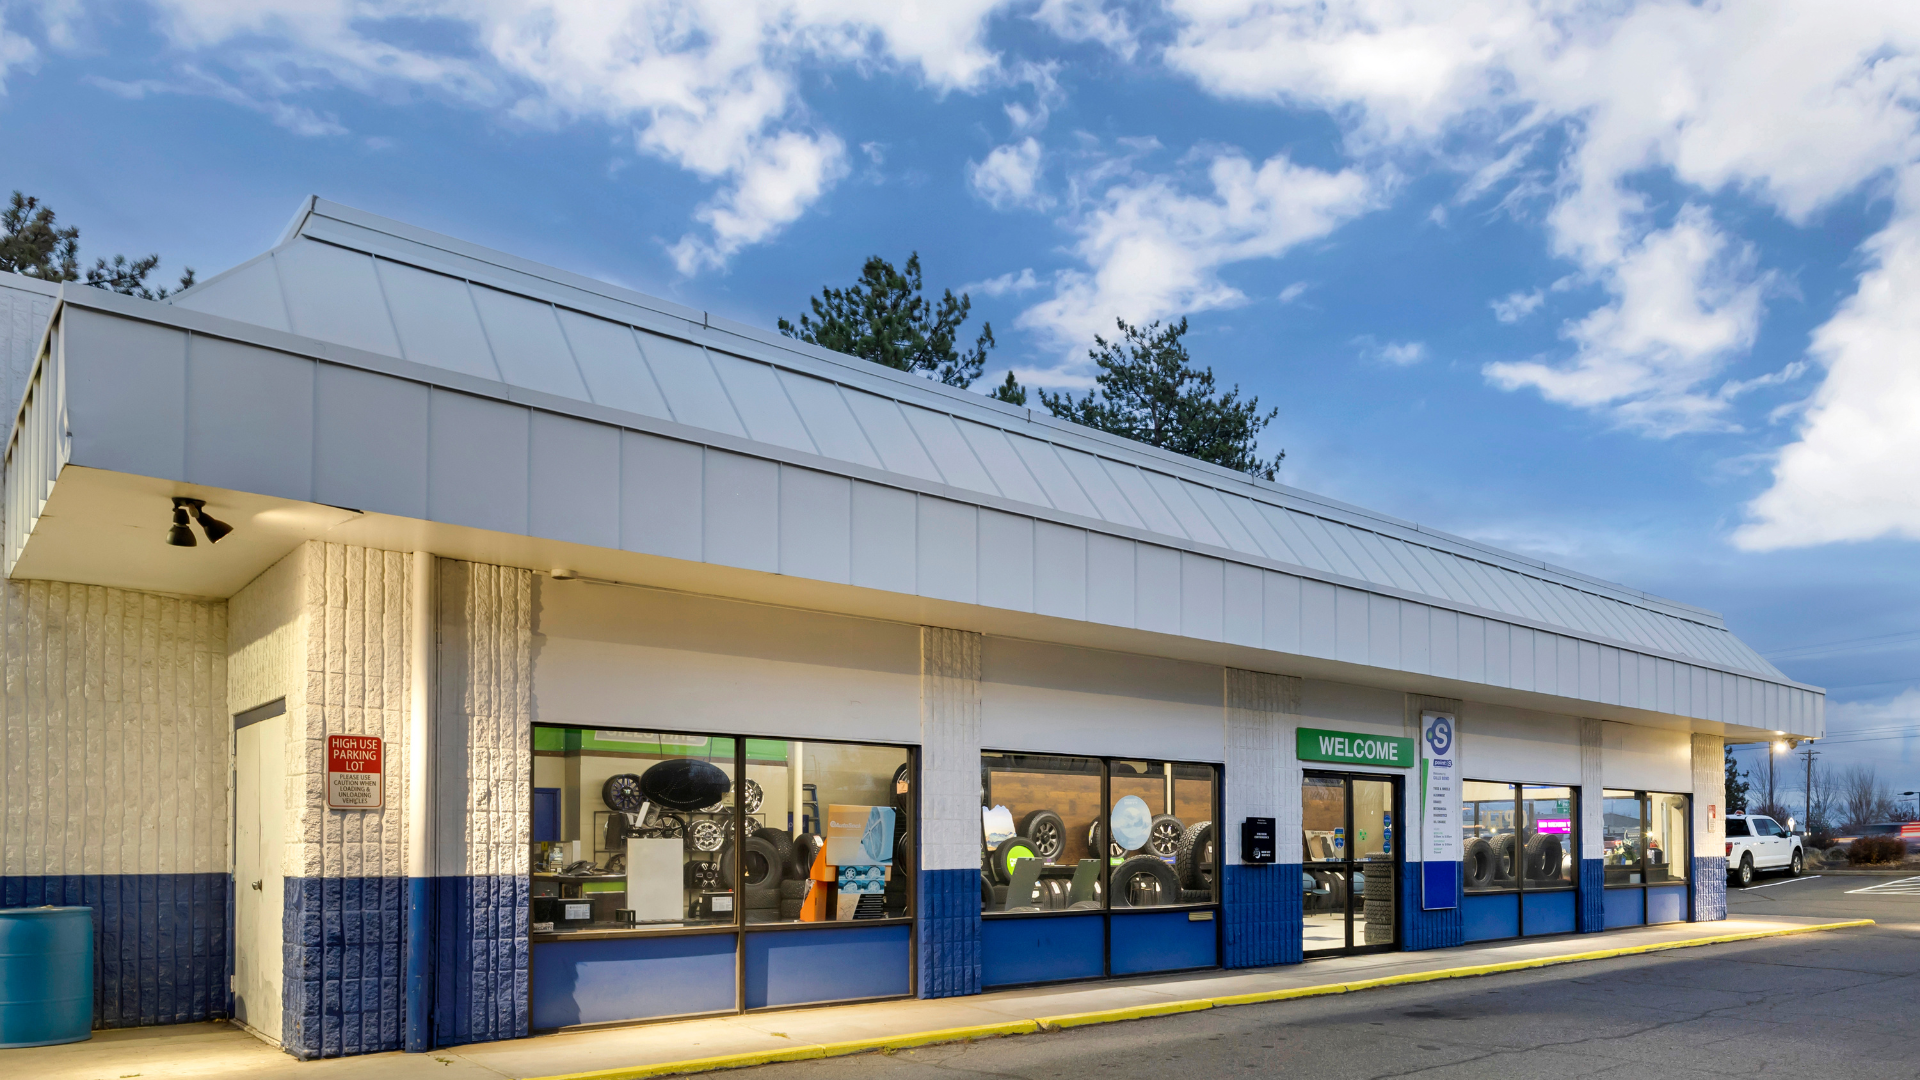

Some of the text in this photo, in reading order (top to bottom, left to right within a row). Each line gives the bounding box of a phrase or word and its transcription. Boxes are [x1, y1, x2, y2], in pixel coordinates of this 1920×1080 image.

[332, 738, 378, 750] HIGH USE
[1319, 735, 1399, 761] WELCOME
[333, 749, 377, 761] PARKING
[345, 761, 365, 771] LOT
